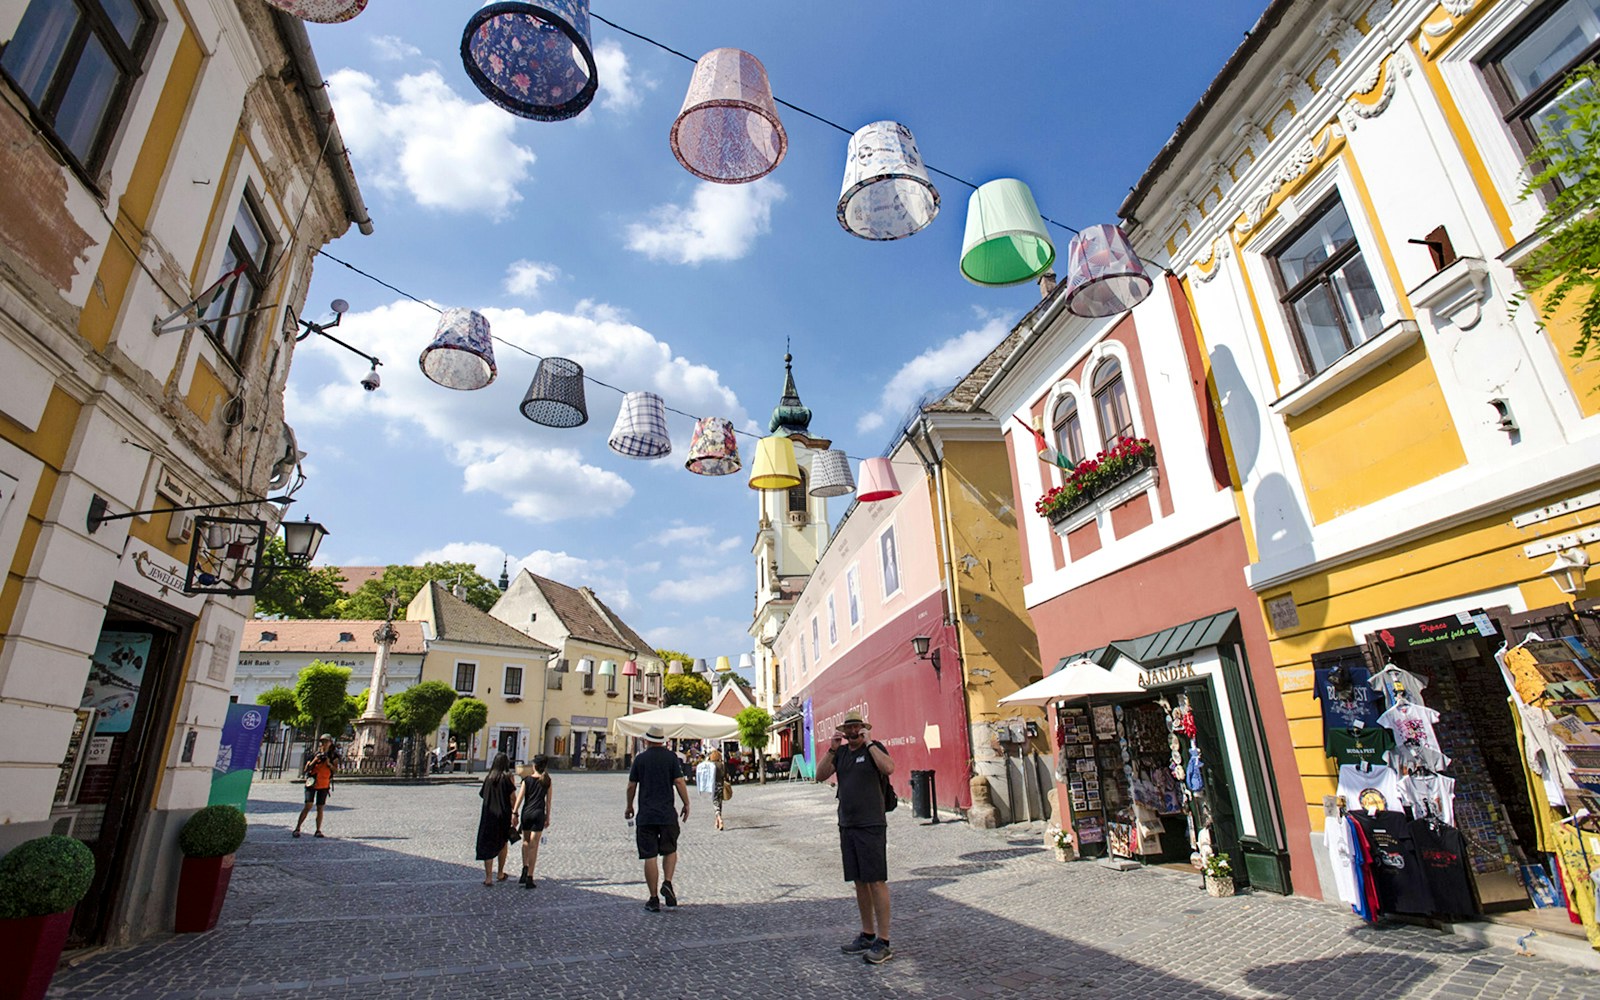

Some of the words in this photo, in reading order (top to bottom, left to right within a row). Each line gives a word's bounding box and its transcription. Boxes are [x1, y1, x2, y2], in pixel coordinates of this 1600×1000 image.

[1419, 622, 1448, 633] Pipacs
[1435, 632, 1449, 641] and
[1450, 628, 1465, 640] folk
[1466, 627, 1479, 635] art
